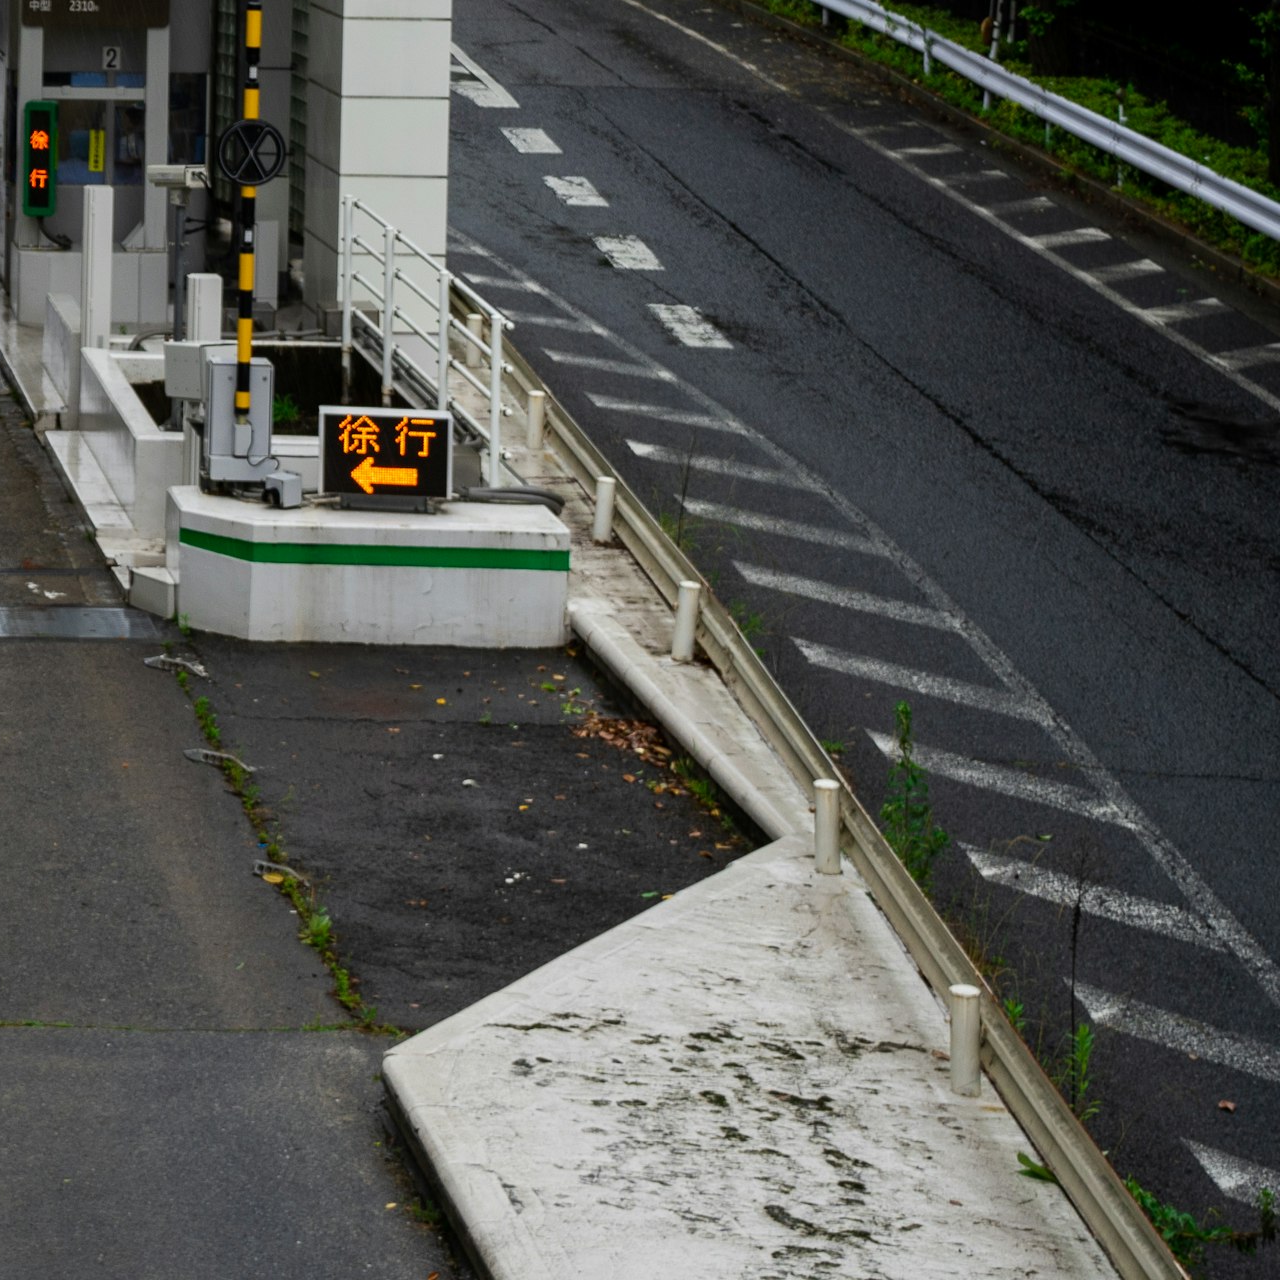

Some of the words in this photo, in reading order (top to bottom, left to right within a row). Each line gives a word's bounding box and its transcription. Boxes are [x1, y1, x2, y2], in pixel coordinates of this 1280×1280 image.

[29, 0, 52, 12] 中型
[105, 47, 118, 68] 2
[29, 129, 50, 189] 徐行
[338, 413, 437, 458] 徐行
